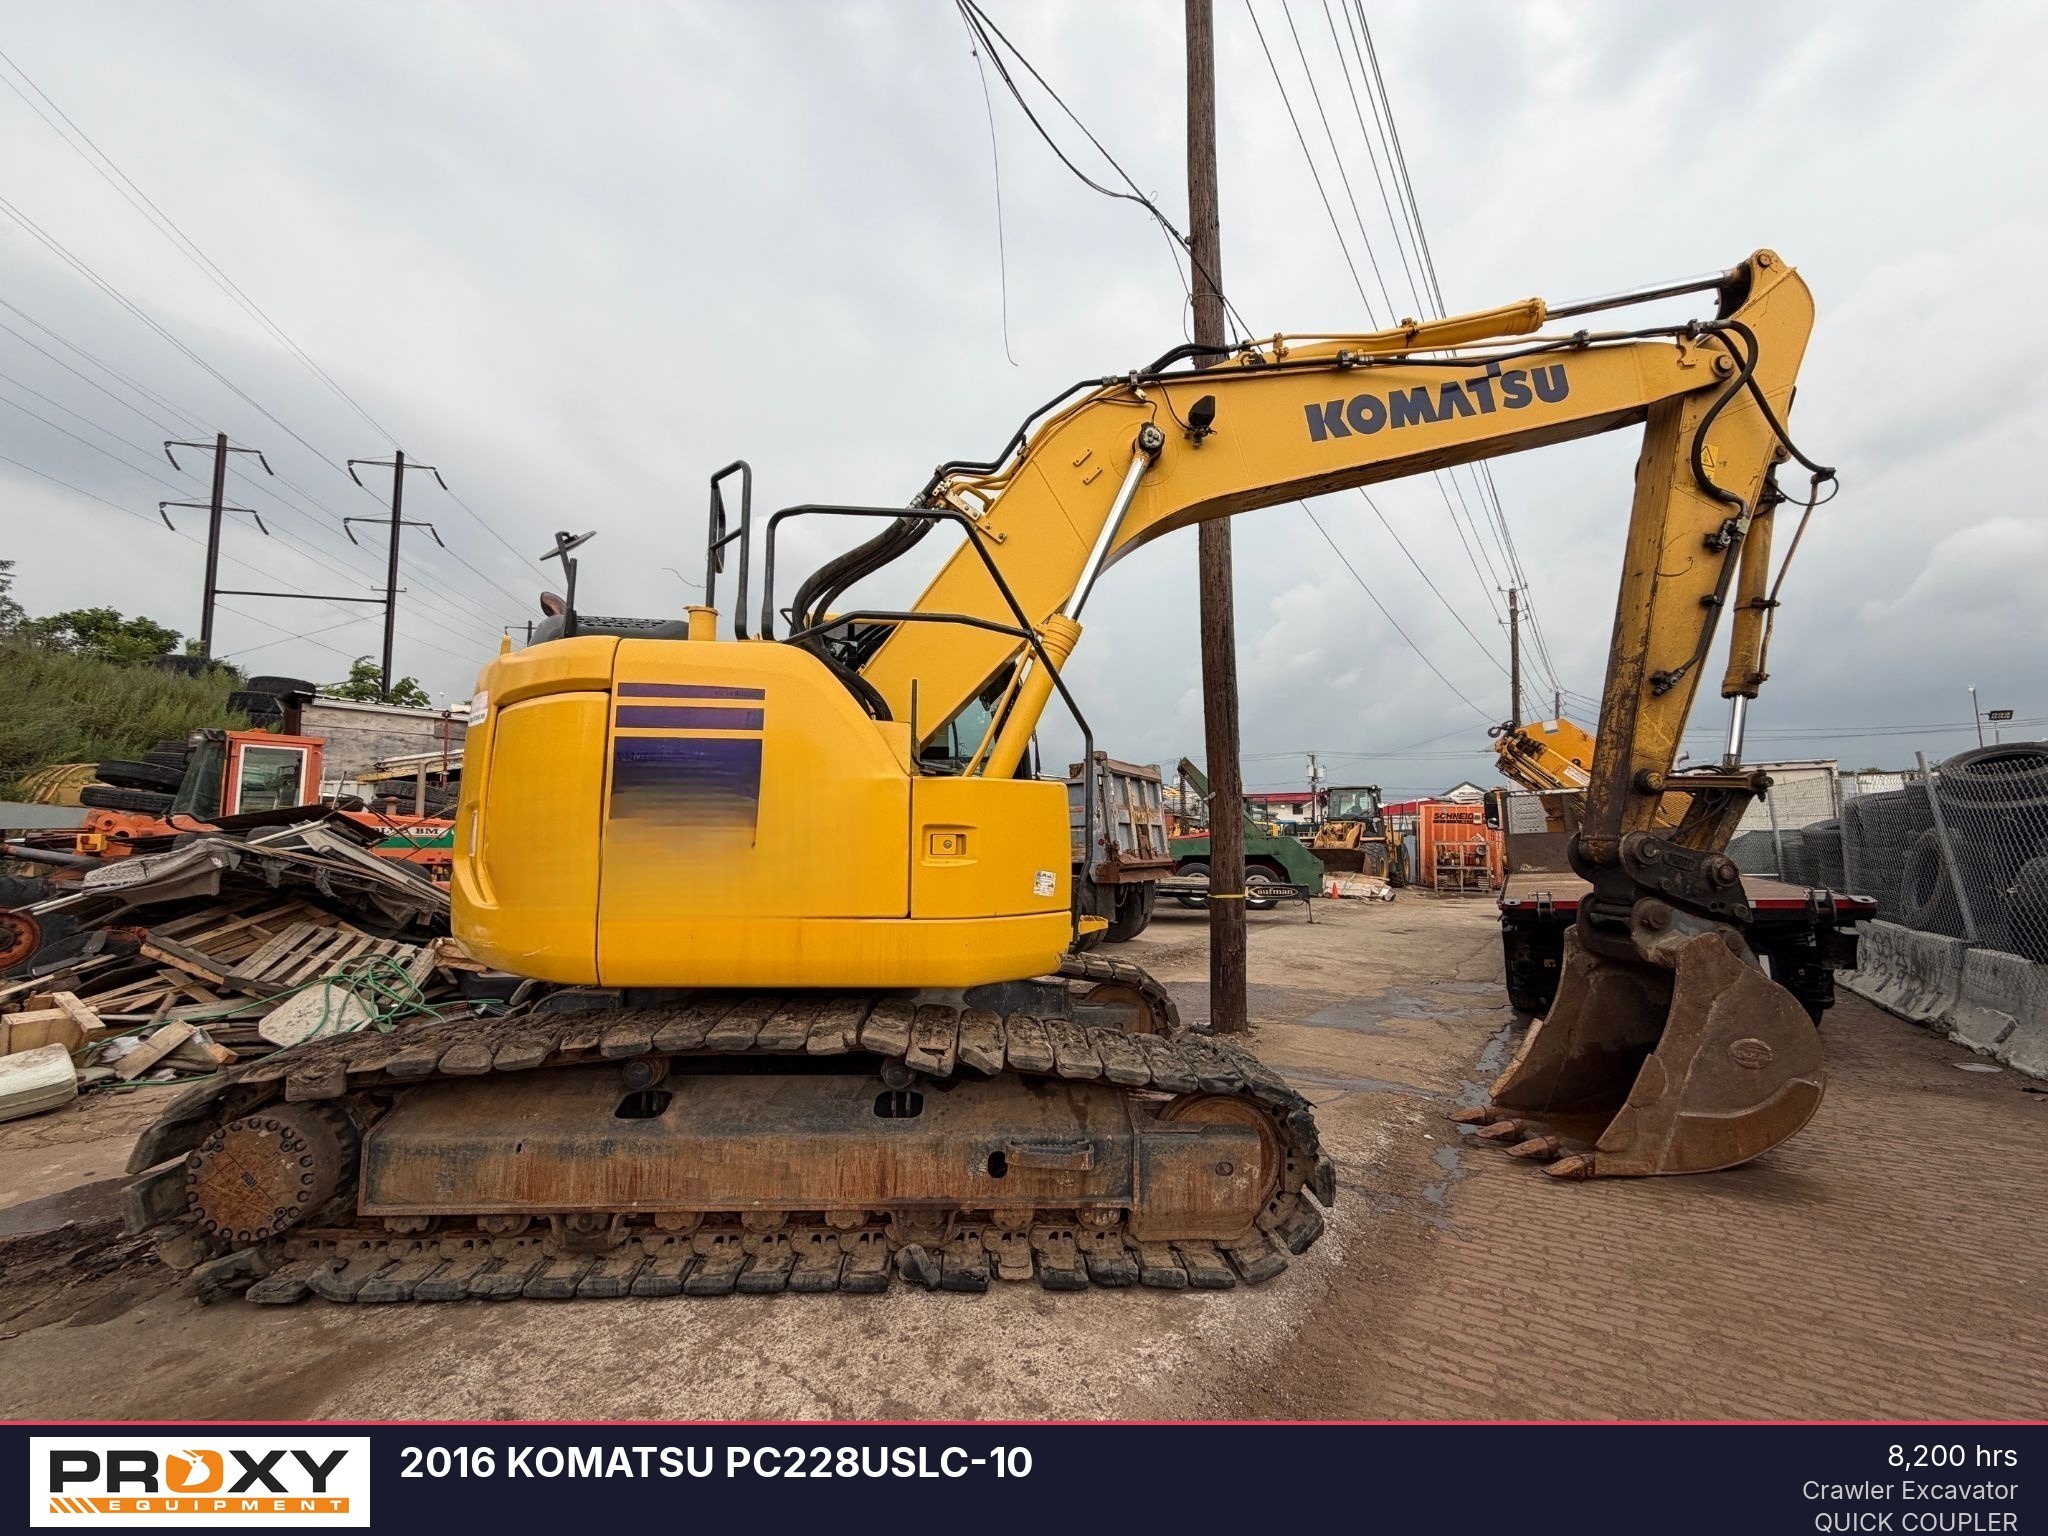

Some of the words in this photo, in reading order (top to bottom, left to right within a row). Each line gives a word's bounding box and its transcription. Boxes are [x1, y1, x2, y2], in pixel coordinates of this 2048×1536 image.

[1304, 363, 1569, 442] KOMATSU
[1433, 812, 1486, 820] SCHNEID
[415, 827, 439, 835] BM
[1245, 886, 1293, 897] Kaufman
